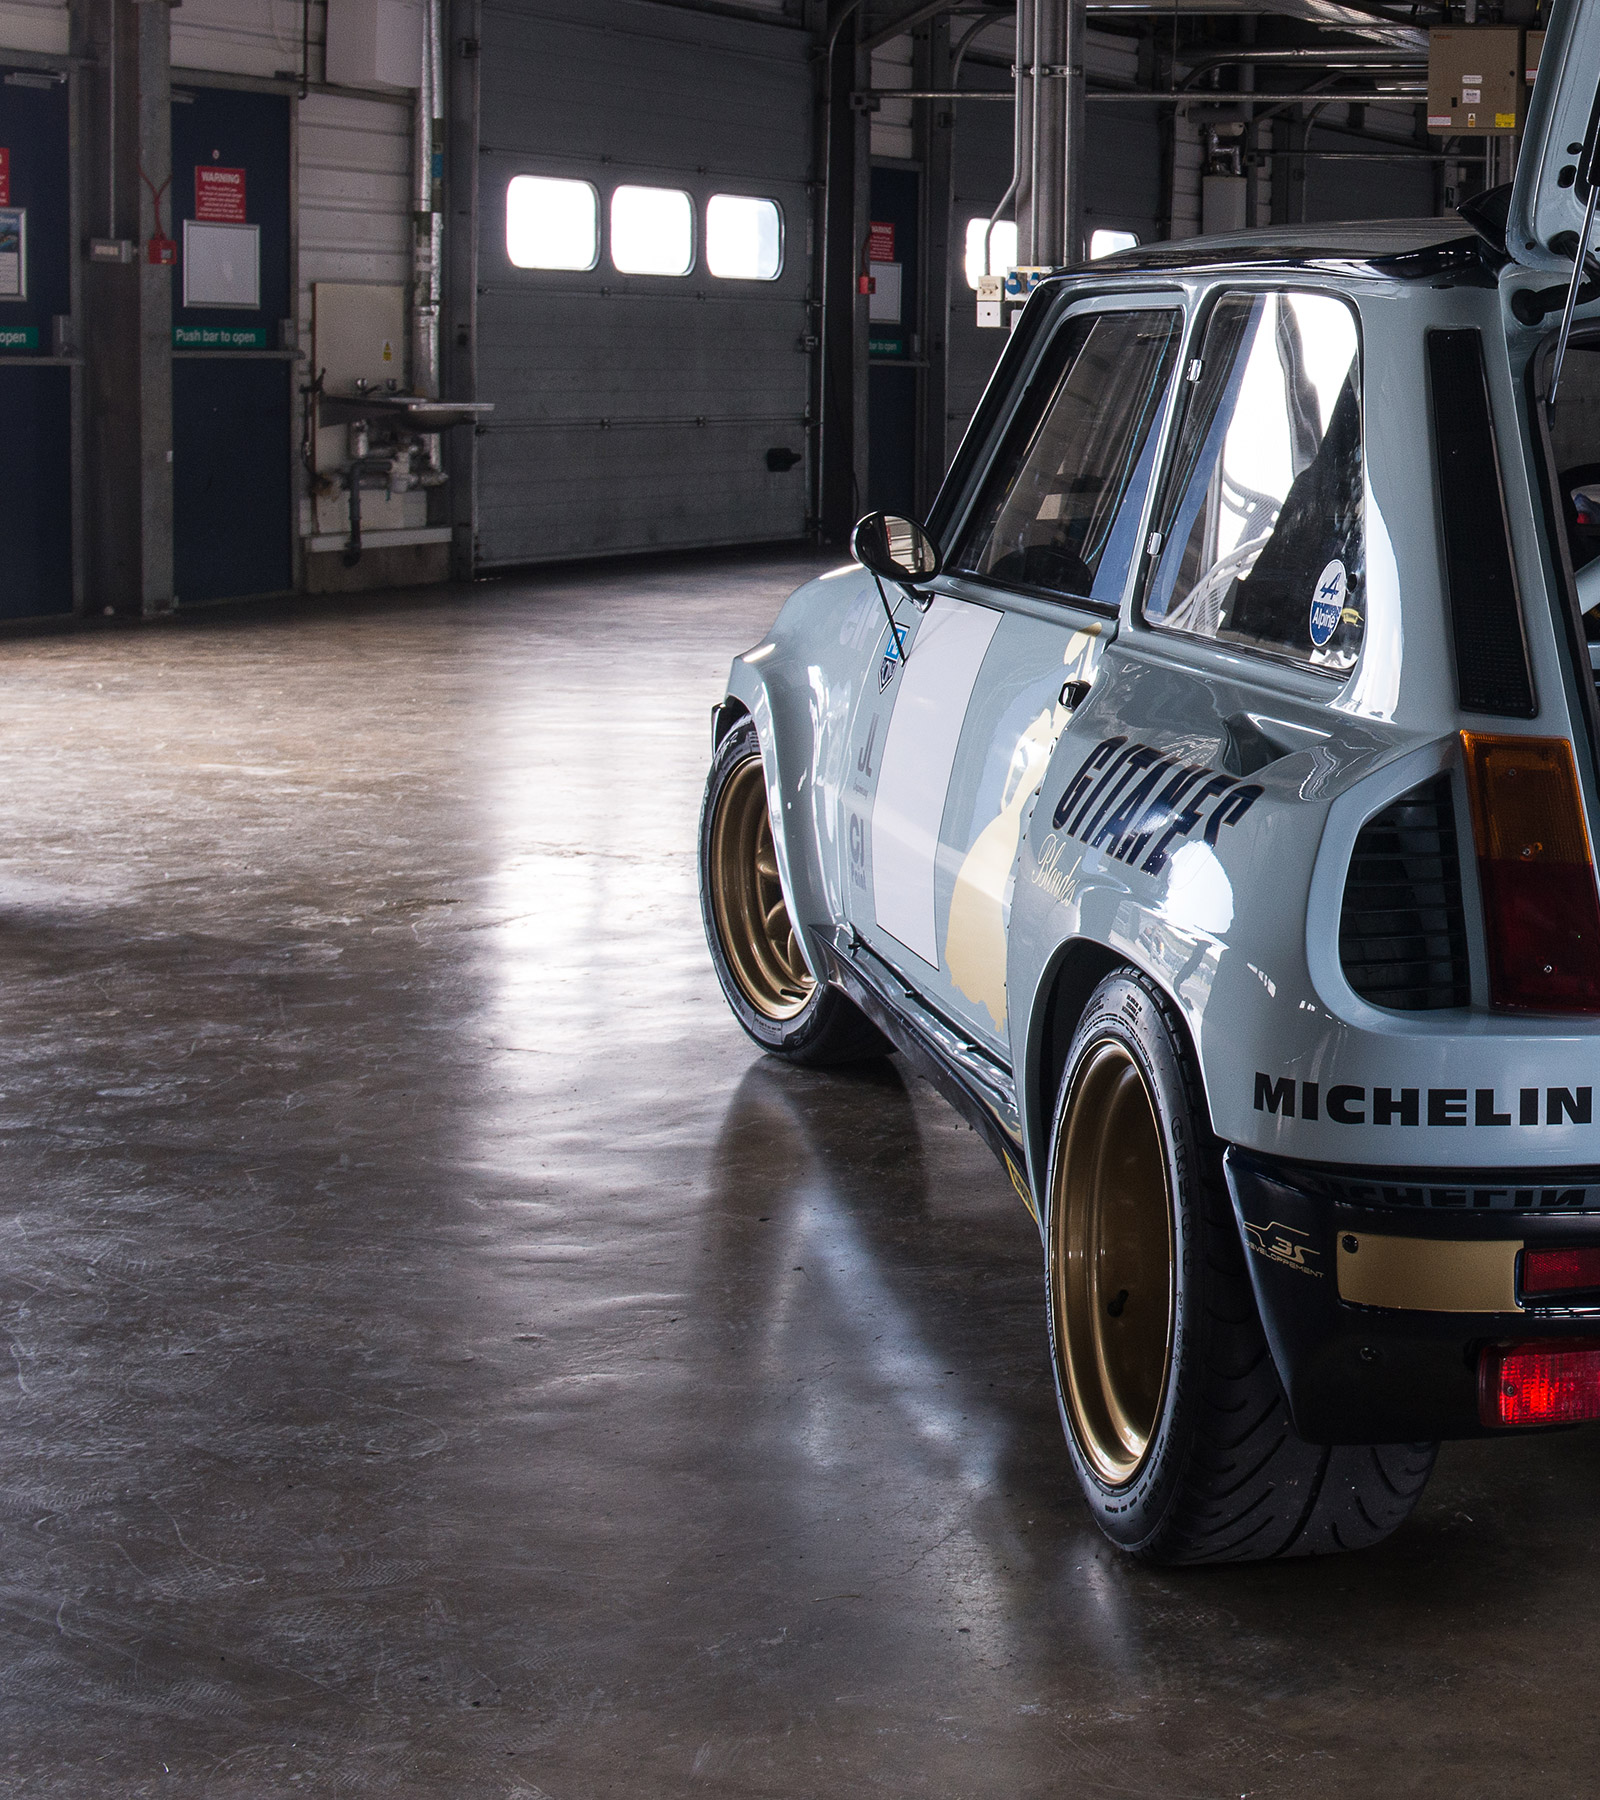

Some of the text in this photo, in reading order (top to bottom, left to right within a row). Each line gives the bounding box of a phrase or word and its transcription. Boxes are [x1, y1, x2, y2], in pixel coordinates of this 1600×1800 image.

[201, 171, 241, 184] WARNING
[0, 332, 27, 347] open
[176, 328, 256, 346] Push bar to open
[1312, 607, 1337, 629] Alpine
[1031, 833, 1083, 907] Blondes
[1253, 1071, 1593, 1127] MICHELIN
[1244, 1238, 1325, 1278] DEVELOPPEMENT
